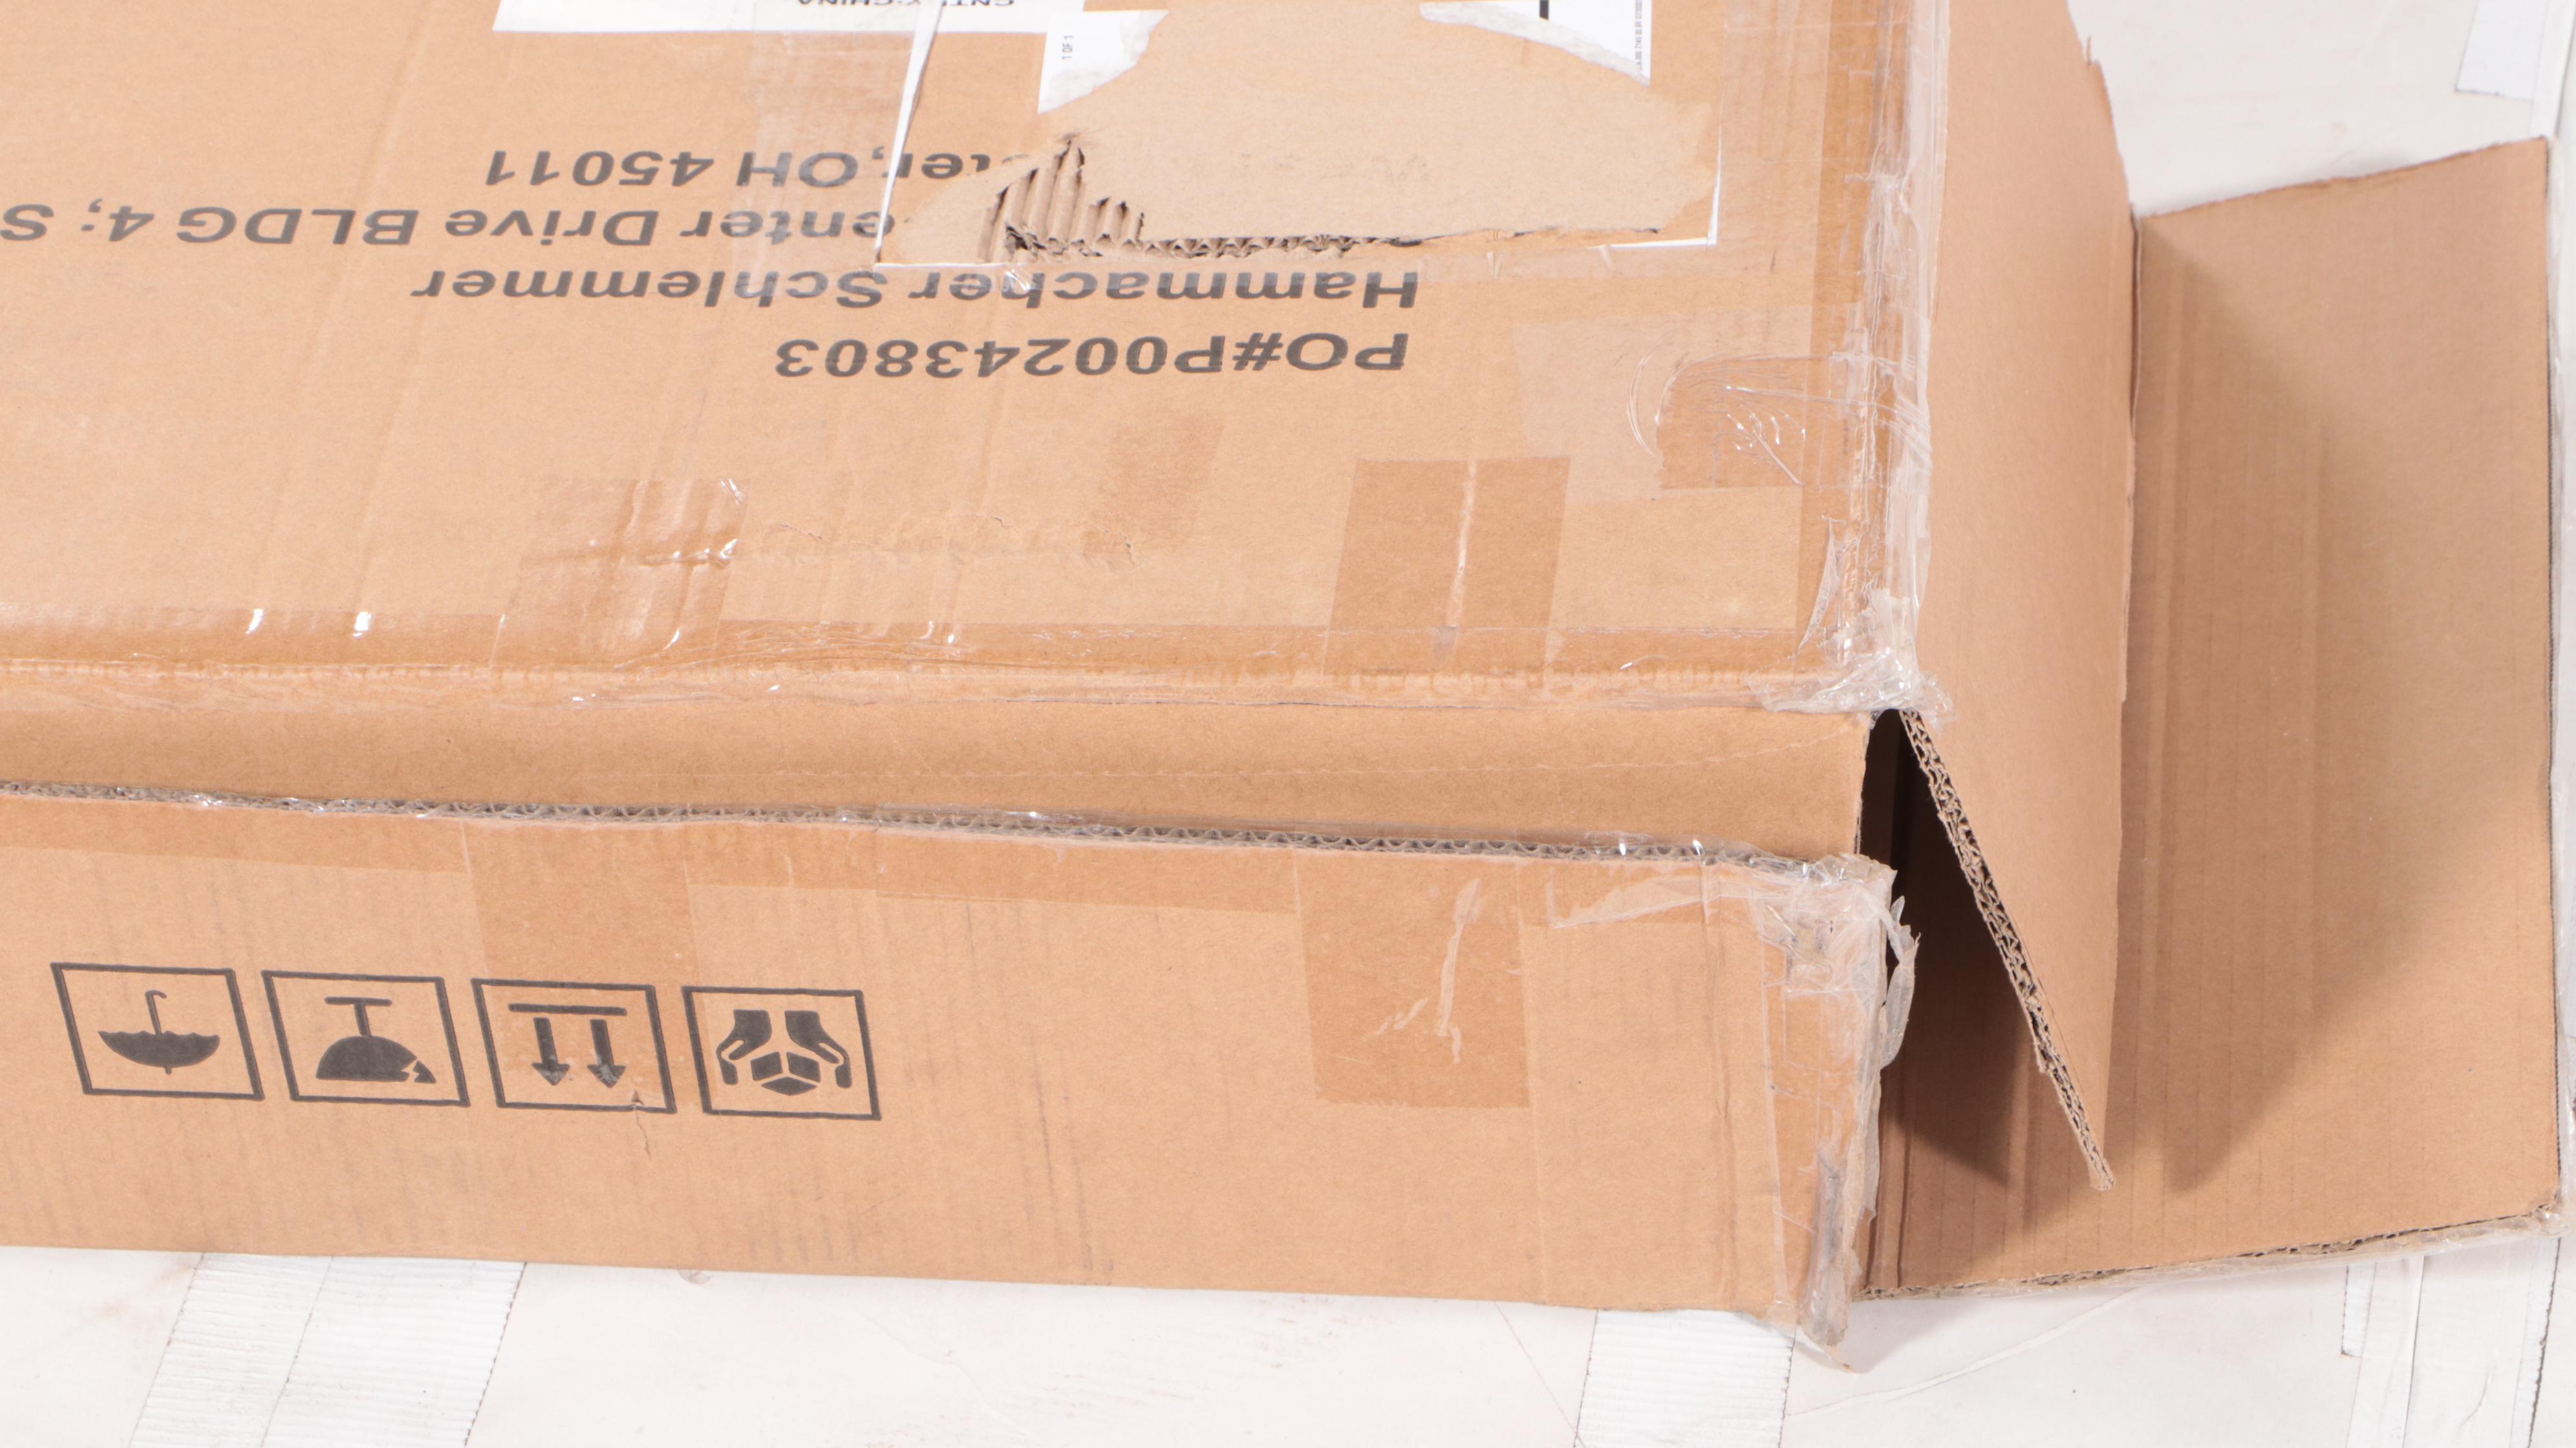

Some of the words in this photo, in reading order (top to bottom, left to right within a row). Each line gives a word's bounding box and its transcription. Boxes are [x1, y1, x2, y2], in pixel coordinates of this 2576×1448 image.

[1062, 42, 1073, 53] OF
[486, 151, 714, 186] 45011
[80, 198, 153, 242] 4;
[178, 208, 418, 244] BLDG
[446, 210, 658, 246] Drive
[411, 270, 887, 310] Schlemmer
[908, 271, 1418, 308] Hammacher
[776, 332, 1408, 378] PO#P00243803
